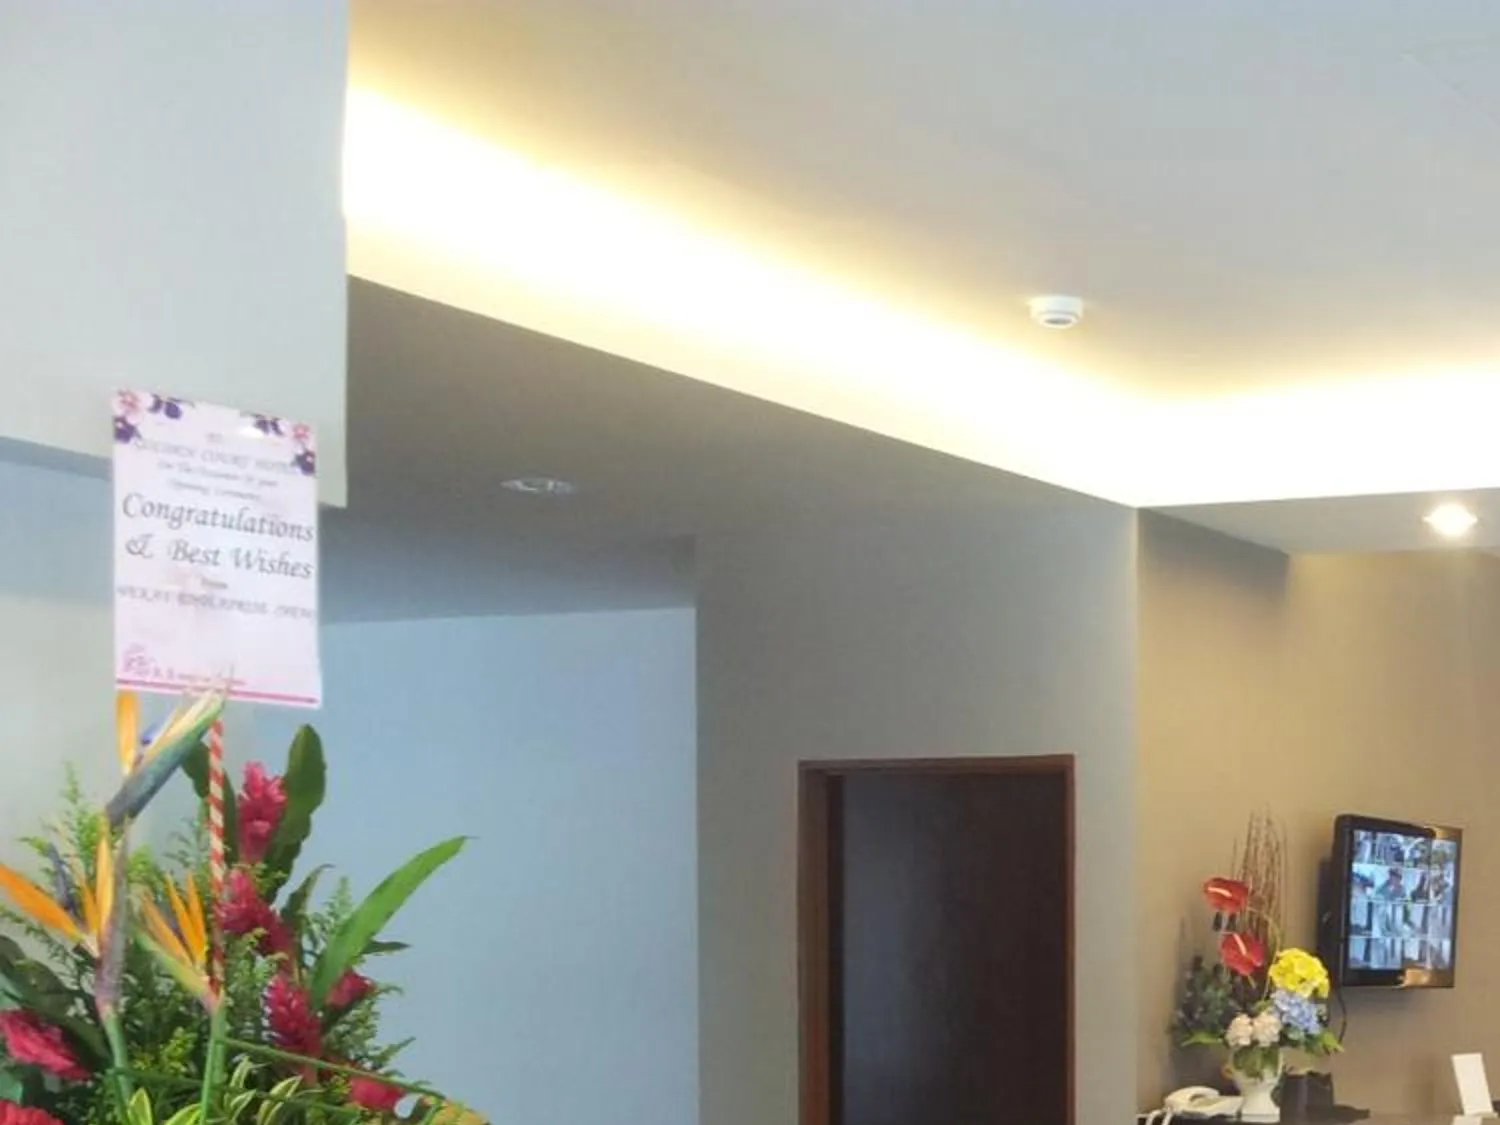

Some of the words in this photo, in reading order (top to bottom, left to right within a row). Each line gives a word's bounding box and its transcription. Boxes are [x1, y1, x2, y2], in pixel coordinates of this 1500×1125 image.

[122, 491, 315, 542] Congratulations
[125, 533, 156, 559] &
[170, 541, 222, 567] Best
[232, 547, 314, 579] Wishes
